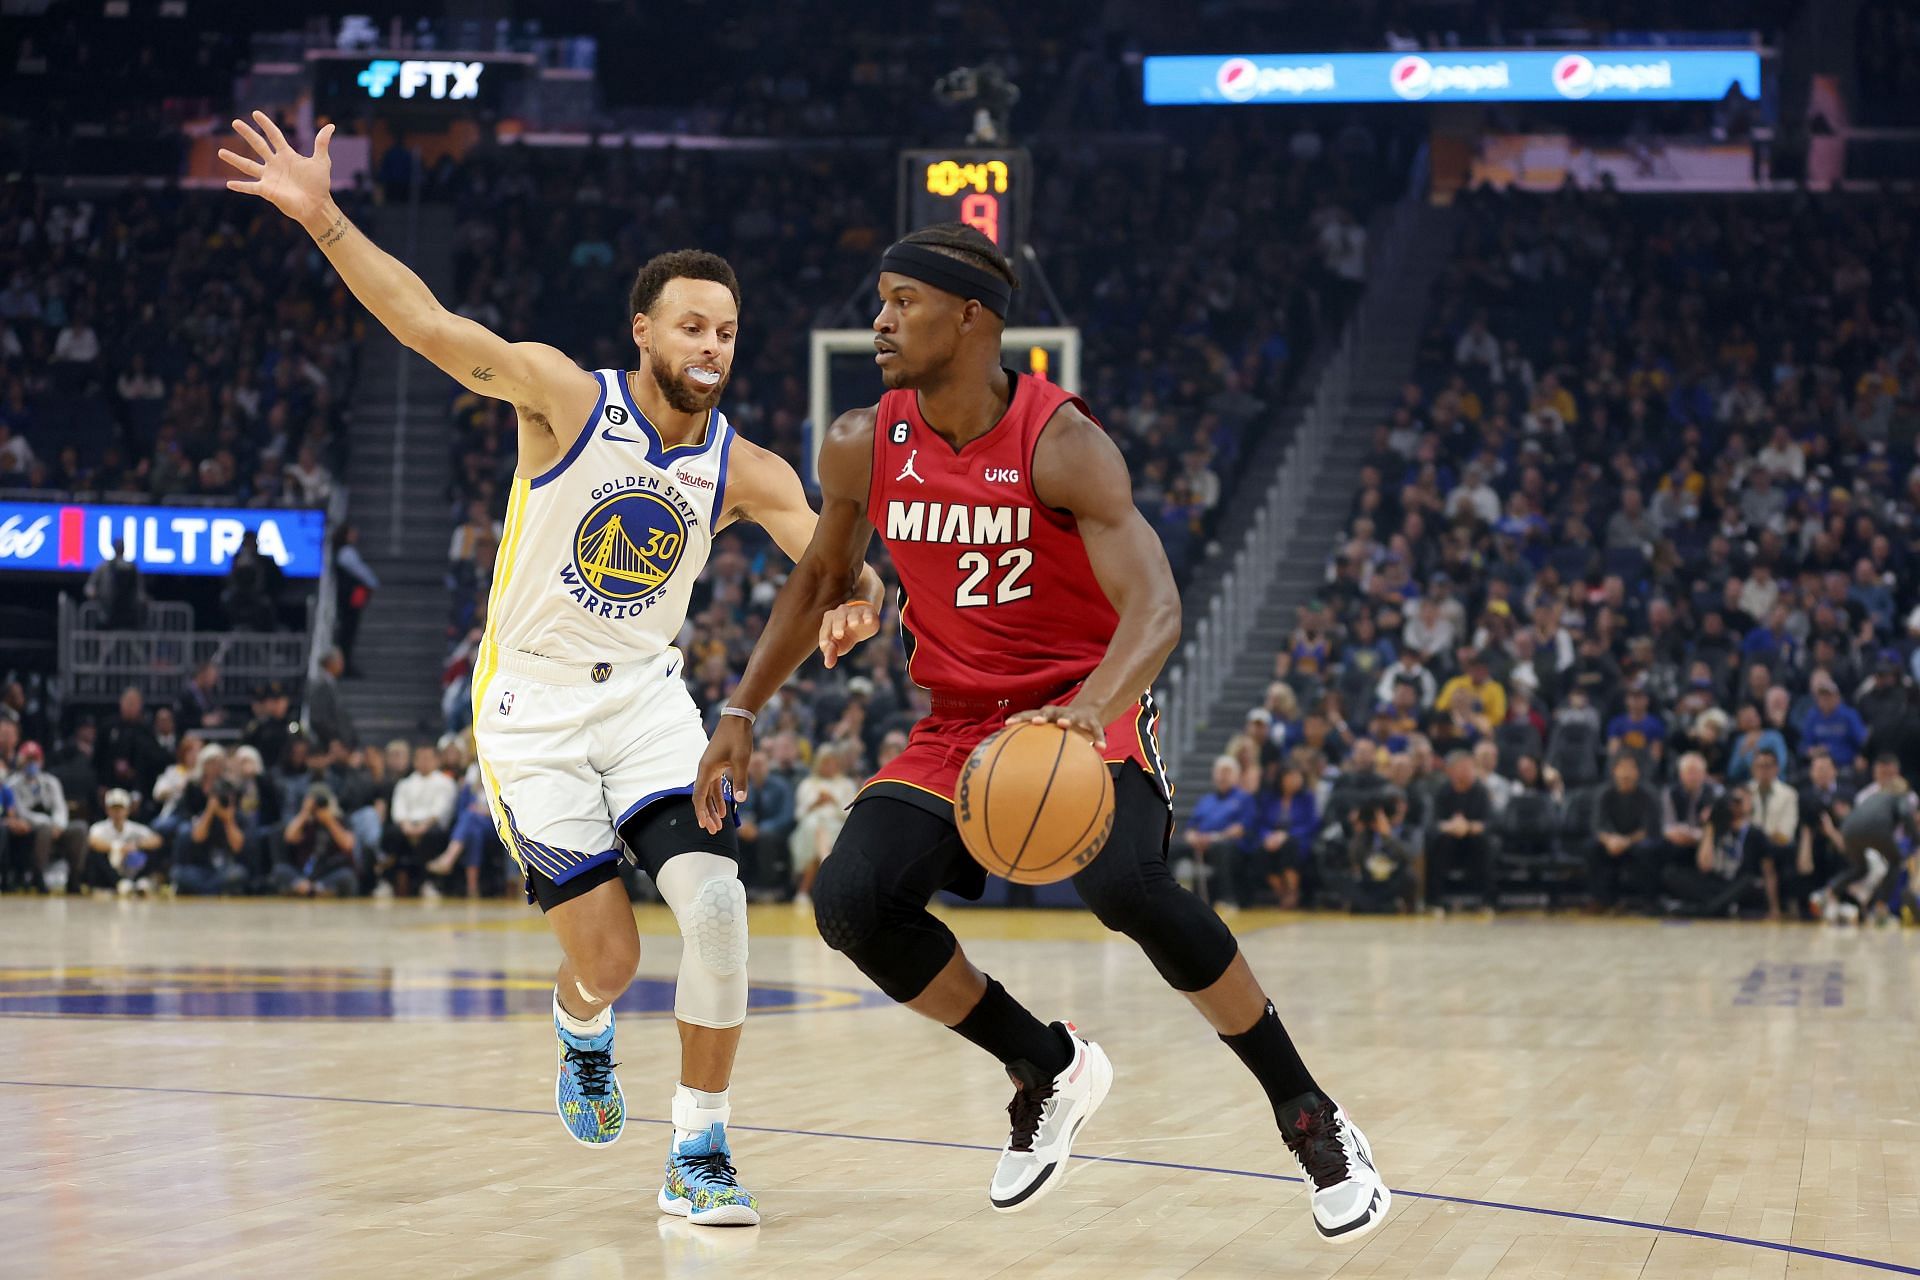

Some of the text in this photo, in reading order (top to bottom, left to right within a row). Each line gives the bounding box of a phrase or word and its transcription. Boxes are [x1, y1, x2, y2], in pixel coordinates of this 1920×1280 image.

[400, 60, 484, 99] FTX
[1257, 63, 1335, 94] pepsi
[1431, 61, 1510, 93] pepsi
[1594, 60, 1673, 92] pepsi
[927, 160, 1008, 196] 10:47
[609, 407, 623, 423] 6
[893, 423, 908, 443] 6
[591, 476, 698, 528] GOLDEN STATE
[886, 500, 1032, 545] MIAMI
[98, 515, 291, 567] ULTRA
[640, 527, 680, 560] 30
[560, 562, 667, 619] WARRIORS
[955, 548, 1034, 608] 22
